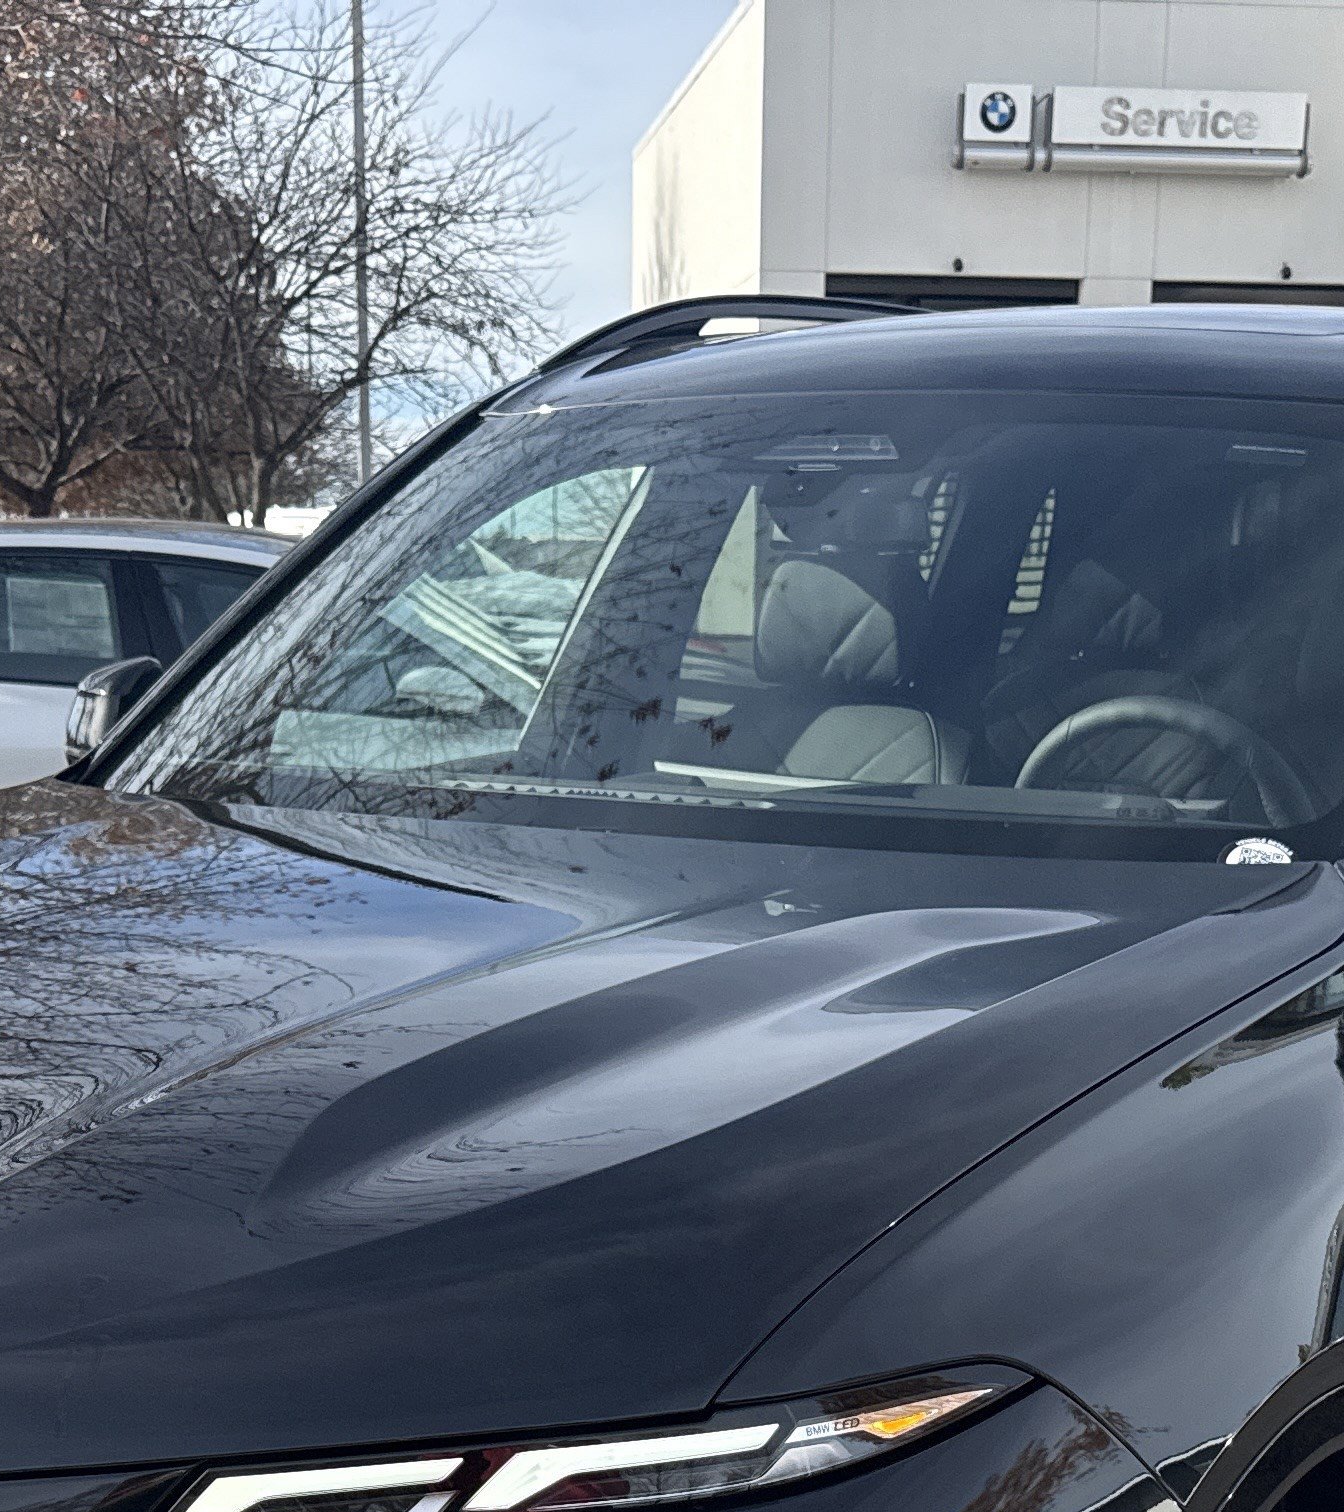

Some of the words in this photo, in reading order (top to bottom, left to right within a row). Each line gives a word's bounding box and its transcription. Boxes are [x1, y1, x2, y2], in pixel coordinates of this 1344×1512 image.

[1101, 97, 1258, 140] Service
[806, 1422, 830, 1437] BMW
[834, 1417, 860, 1431] LED
